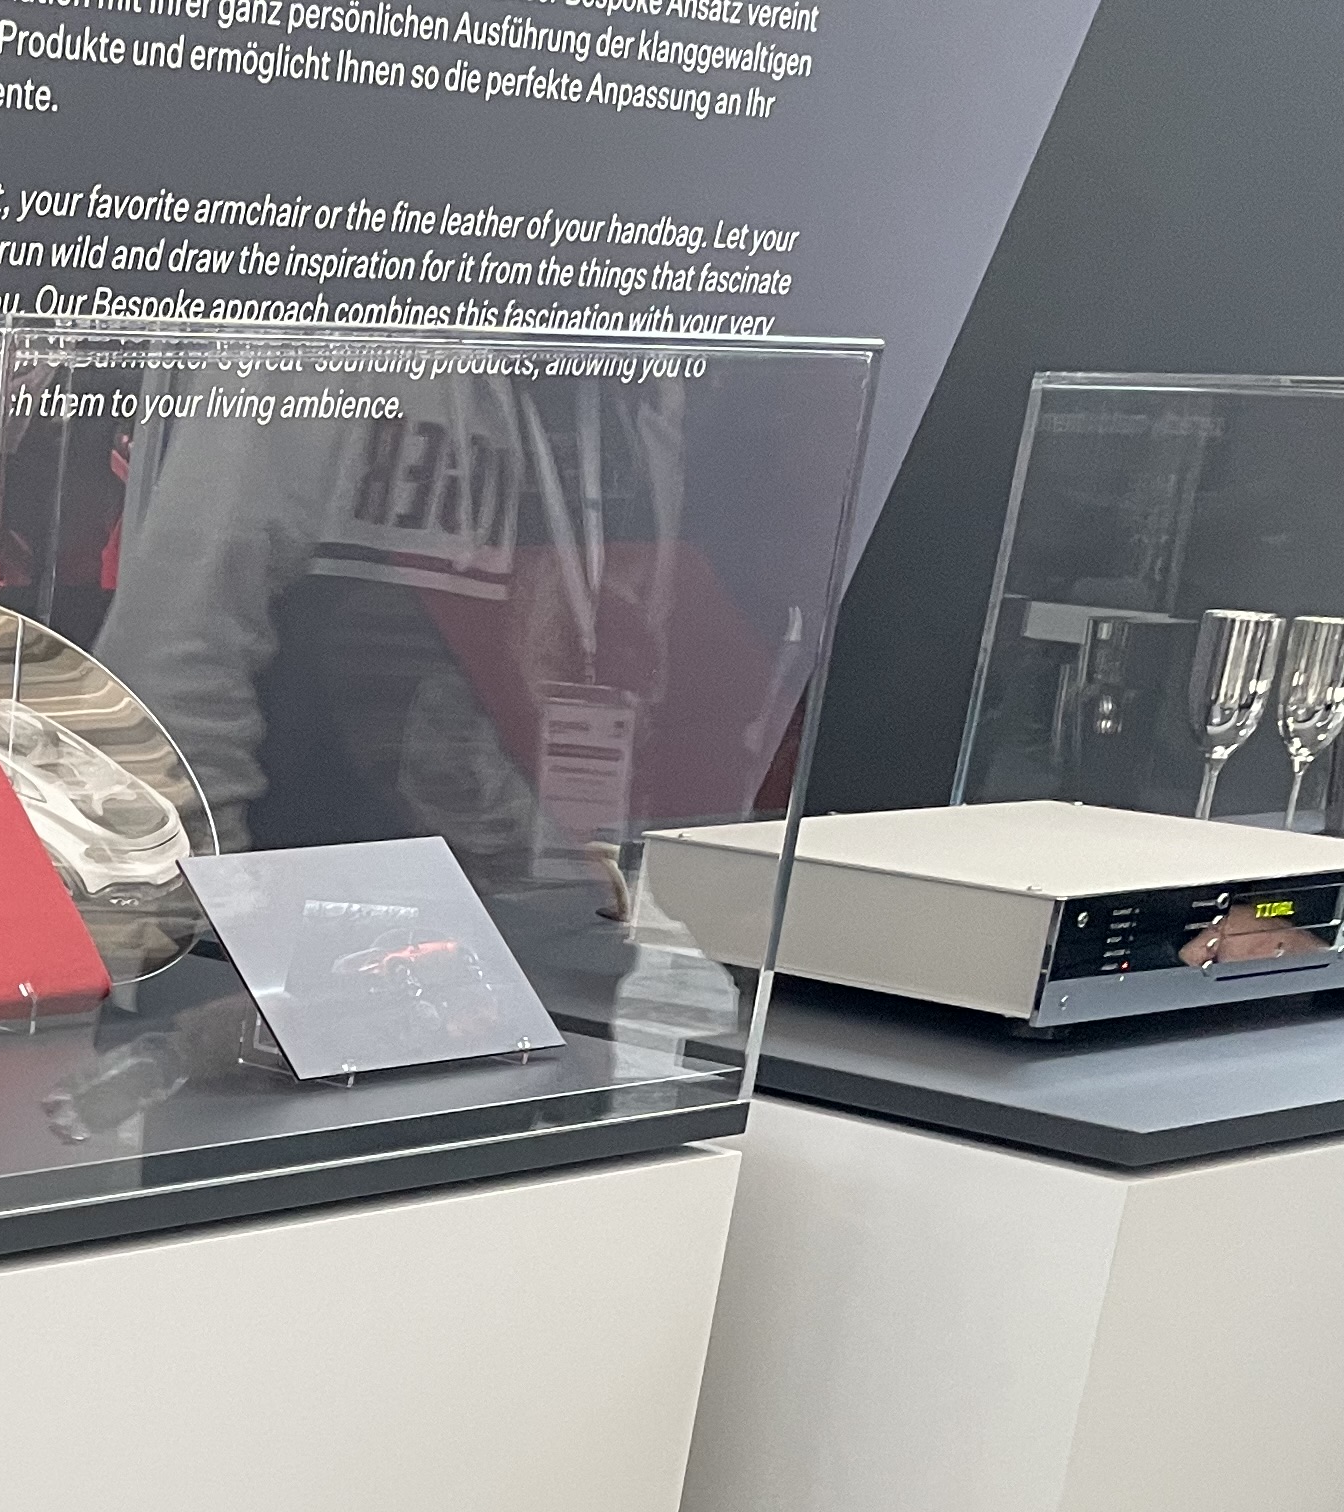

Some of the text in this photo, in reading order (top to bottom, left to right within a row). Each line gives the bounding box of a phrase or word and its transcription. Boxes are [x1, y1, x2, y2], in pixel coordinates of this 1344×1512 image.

[218, 0, 282, 28] ganz
[288, 0, 448, 41] persönlichen
[453, 12, 591, 62] Ausführung
[596, 26, 635, 58] der
[638, 29, 811, 80] klanggewaltigen
[748, 0, 819, 32] vereint
[133, 34, 184, 68] und
[191, 42, 331, 83] ermöglicht
[337, 50, 404, 86] Ihnen
[411, 65, 439, 89] so
[445, 60, 481, 93] die
[486, 66, 582, 101] perfekte
[586, 72, 710, 119] Anpassung
[715, 93, 741, 115] an
[746, 87, 775, 118] Ihr
[17, 191, 83, 222] your
[88, 184, 189, 222] favorite
[194, 194, 312, 227] armchair
[315, 205, 343, 229] or
[346, 198, 386, 231] the
[391, 201, 435, 234] fine
[440, 203, 524, 238] leather
[527, 209, 553, 239] of
[550, 218, 605, 247] your
[607, 213, 707, 254] handbag.
[714, 220, 749, 249] Let
[748, 230, 800, 256] your
[52, 235, 108, 268] wild
[112, 238, 165, 271] and
[169, 239, 234, 273] draw
[239, 242, 280, 275] the
[285, 245, 415, 284] inspiration
[420, 250, 455, 281] for
[457, 252, 475, 282] it
[479, 252, 532, 285] from
[537, 256, 573, 286] the
[578, 257, 647, 295] things
[651, 261, 695, 291] that
[698, 262, 791, 295] fascinate
[34, 284, 88, 316] Our
[91, 286, 205, 319] Bespoke
[209, 289, 330, 322] approach
[333, 295, 450, 325] combines
[455, 298, 499, 327] this
[503, 300, 624, 331] fascination
[628, 304, 676, 332] with
[40, 385, 104, 418] them
[112, 389, 137, 417] to
[141, 395, 203, 424] your
[207, 386, 275, 425] living
[281, 388, 403, 418] ambience.
